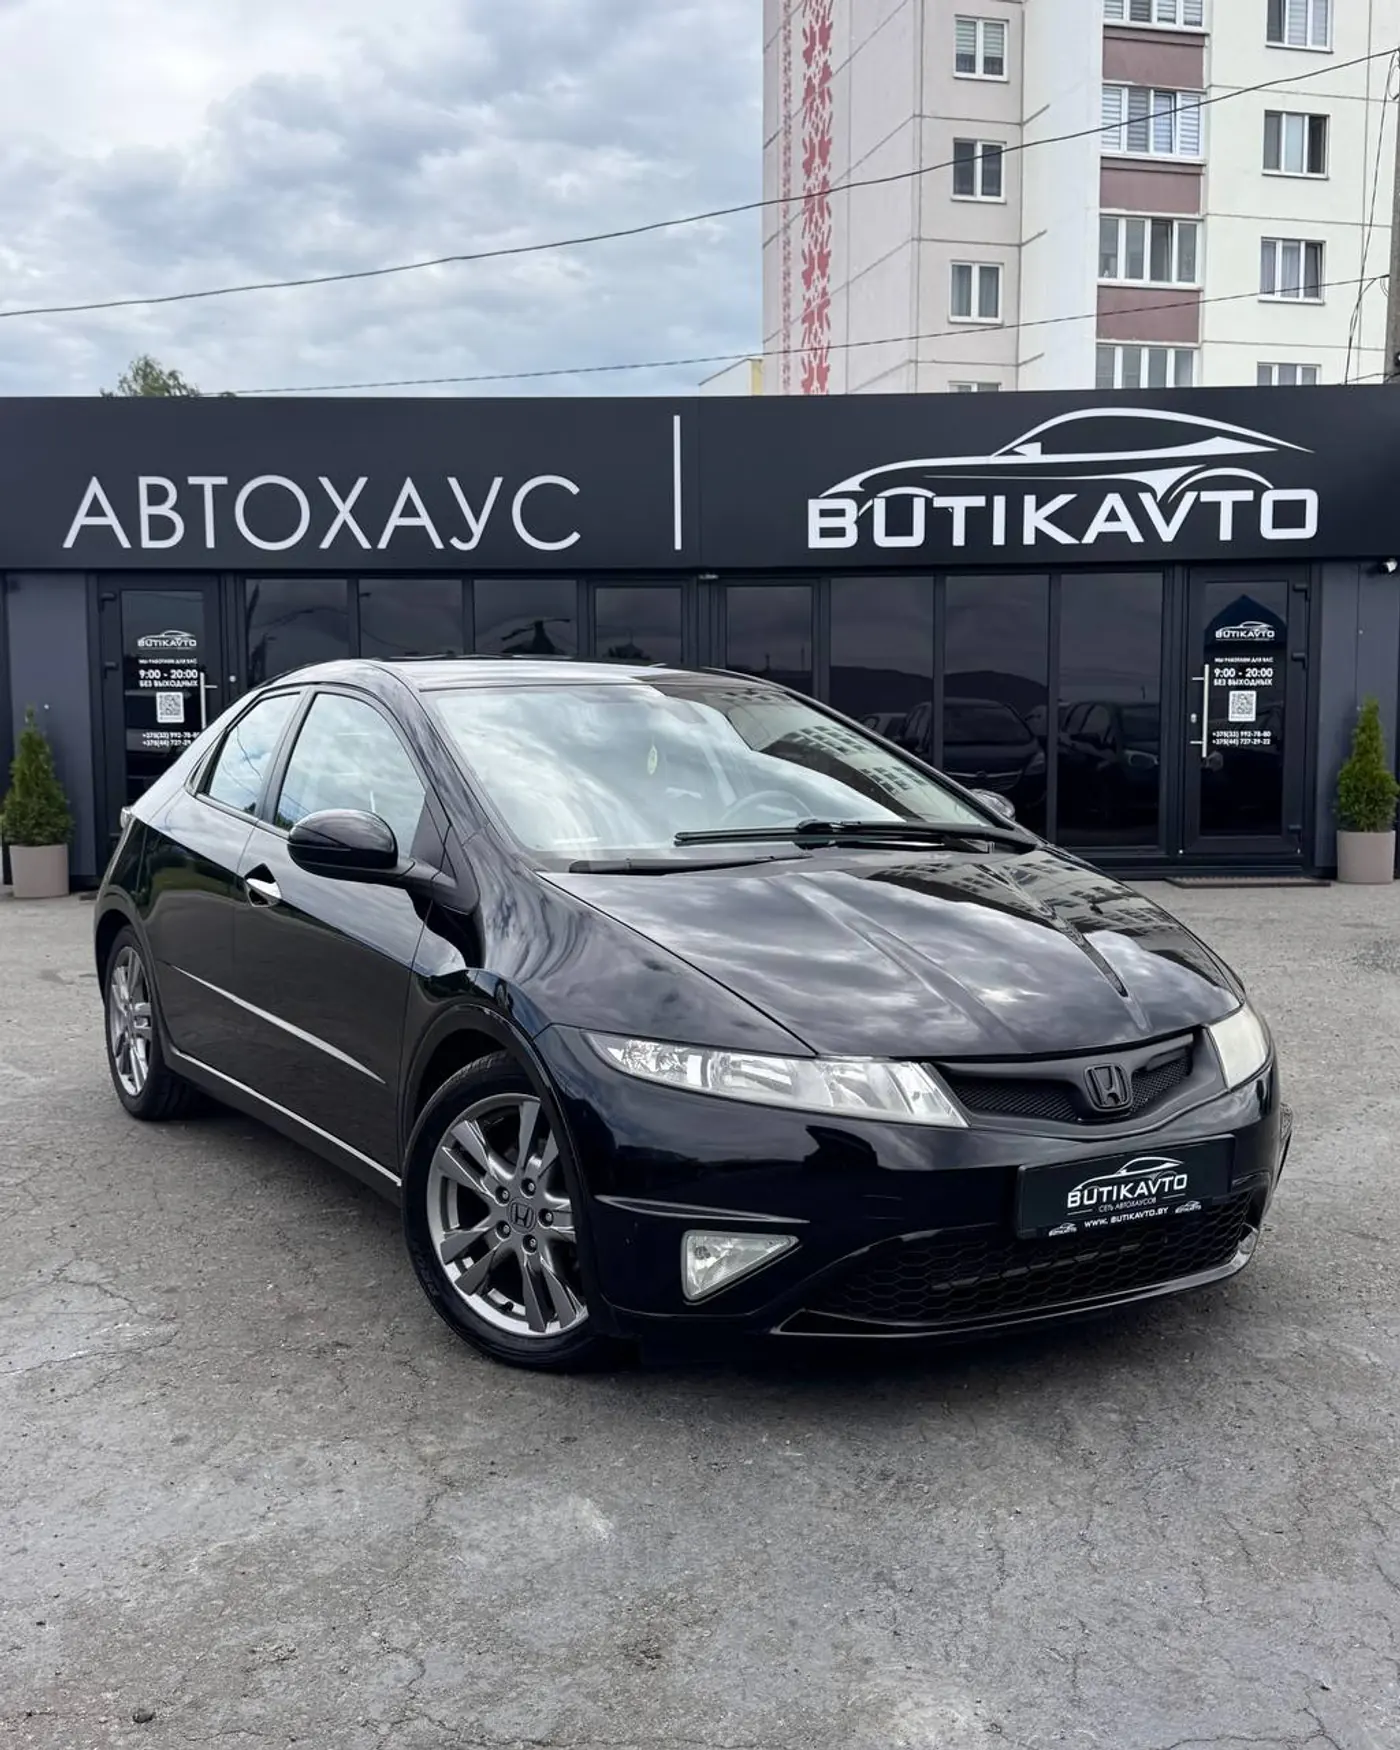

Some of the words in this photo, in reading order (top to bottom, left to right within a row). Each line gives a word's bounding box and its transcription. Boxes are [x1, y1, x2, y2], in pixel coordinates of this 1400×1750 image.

[62, 475, 582, 551] АВТОХАУС
[807, 488, 1319, 549] BUTIKAVTO
[1215, 630, 1275, 639] BUTIKAVTO
[137, 638, 197, 647] BUTIKAVTO
[139, 669, 161, 679] 9:00
[170, 669, 198, 679] 20:00
[1214, 668, 1236, 678] 9:00
[1245, 668, 1273, 678] 20:00
[1214, 678, 1226, 686] БЕЗ
[1227, 678, 1273, 686] ВЫХОДНЫХ
[1066, 1174, 1188, 1208] BUTIKAVTO
[1098, 1204, 1114, 1213] СЕТЬ
[1110, 1207, 1169, 1223] BUTIKAVTO.BY
